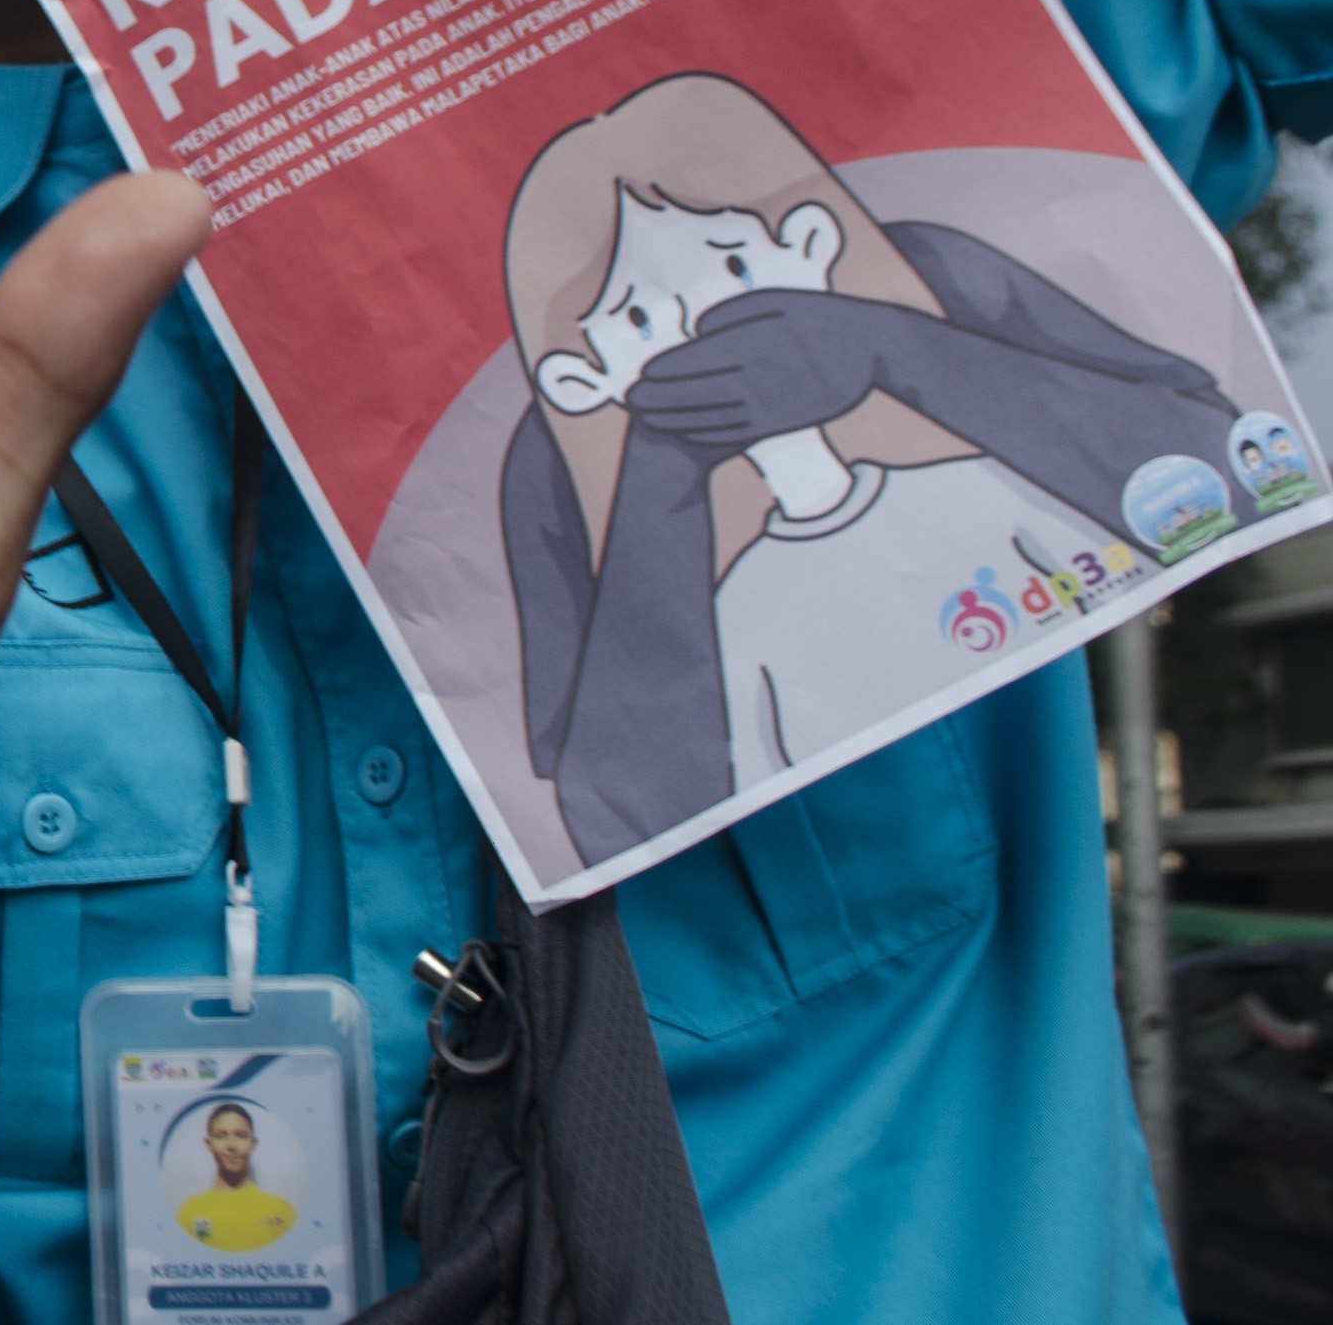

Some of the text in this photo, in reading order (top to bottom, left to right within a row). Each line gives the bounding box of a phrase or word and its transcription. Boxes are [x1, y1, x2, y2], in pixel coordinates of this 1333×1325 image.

[180, 112, 290, 183] MELAKUKAN
[285, 54, 397, 128] KEKERASAN
[392, 27, 449, 71] PADA
[201, 130, 315, 204] ENGASUHAN
[309, 103, 366, 146] YANG
[360, 78, 414, 119] BAIK.
[410, 65, 442, 93] INI
[436, 24, 517, 81] ADALAH
[266, 33, 378, 107] ANAK-ANAK
[373, 6, 429, 49] ATAS
[286, 152, 331, 188] DAN
[326, 103, 423, 169] MEMBAWA
[418, 40, 546, 120] MALAPETAKA
[540, 16, 591, 56] BAGI
[1021, 542, 1134, 615] dp3a
